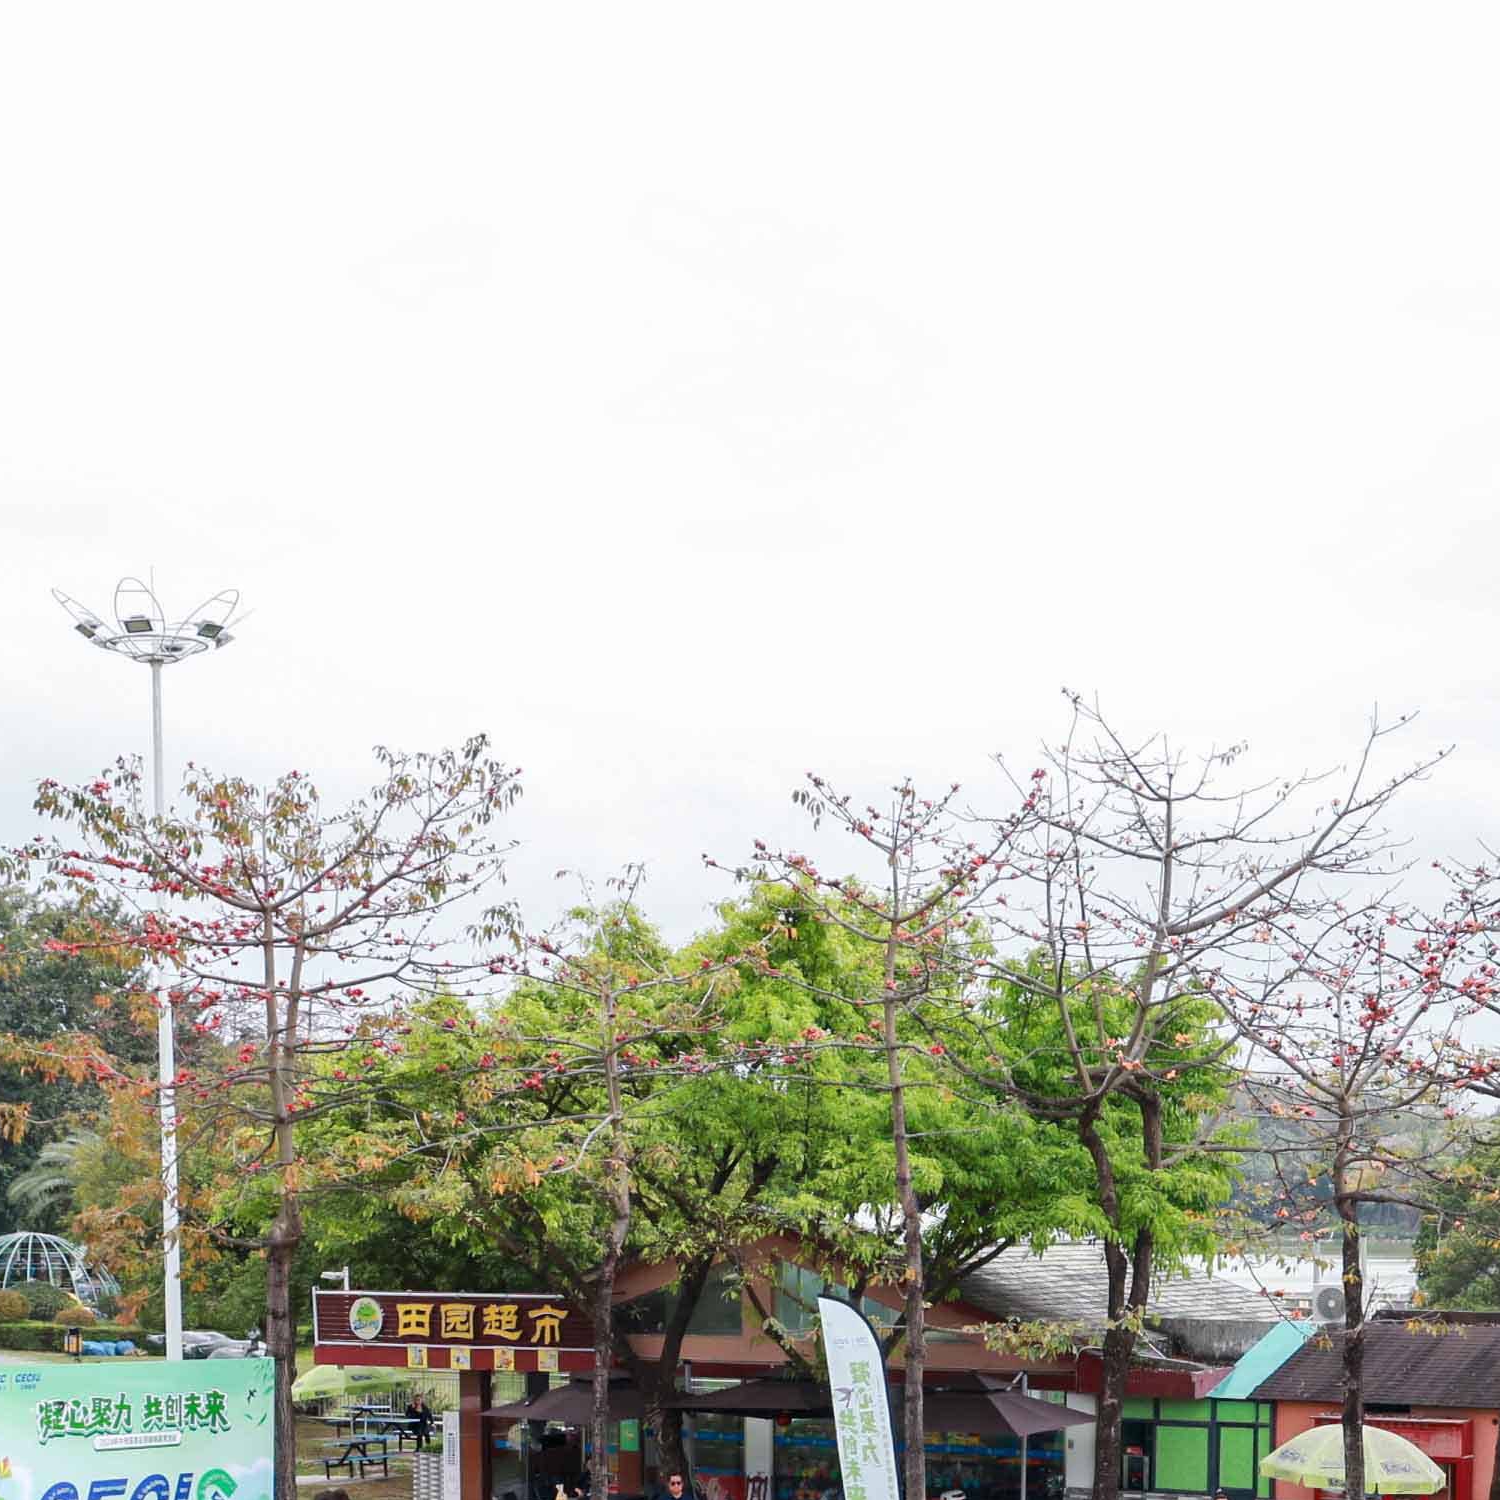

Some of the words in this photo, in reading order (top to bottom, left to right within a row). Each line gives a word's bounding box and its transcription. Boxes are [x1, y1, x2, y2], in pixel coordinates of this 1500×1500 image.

[395, 1303, 569, 1345] 田园超市
[38, 1393, 133, 1442] 凝心聚力
[142, 1389, 232, 1432] 共创未来
